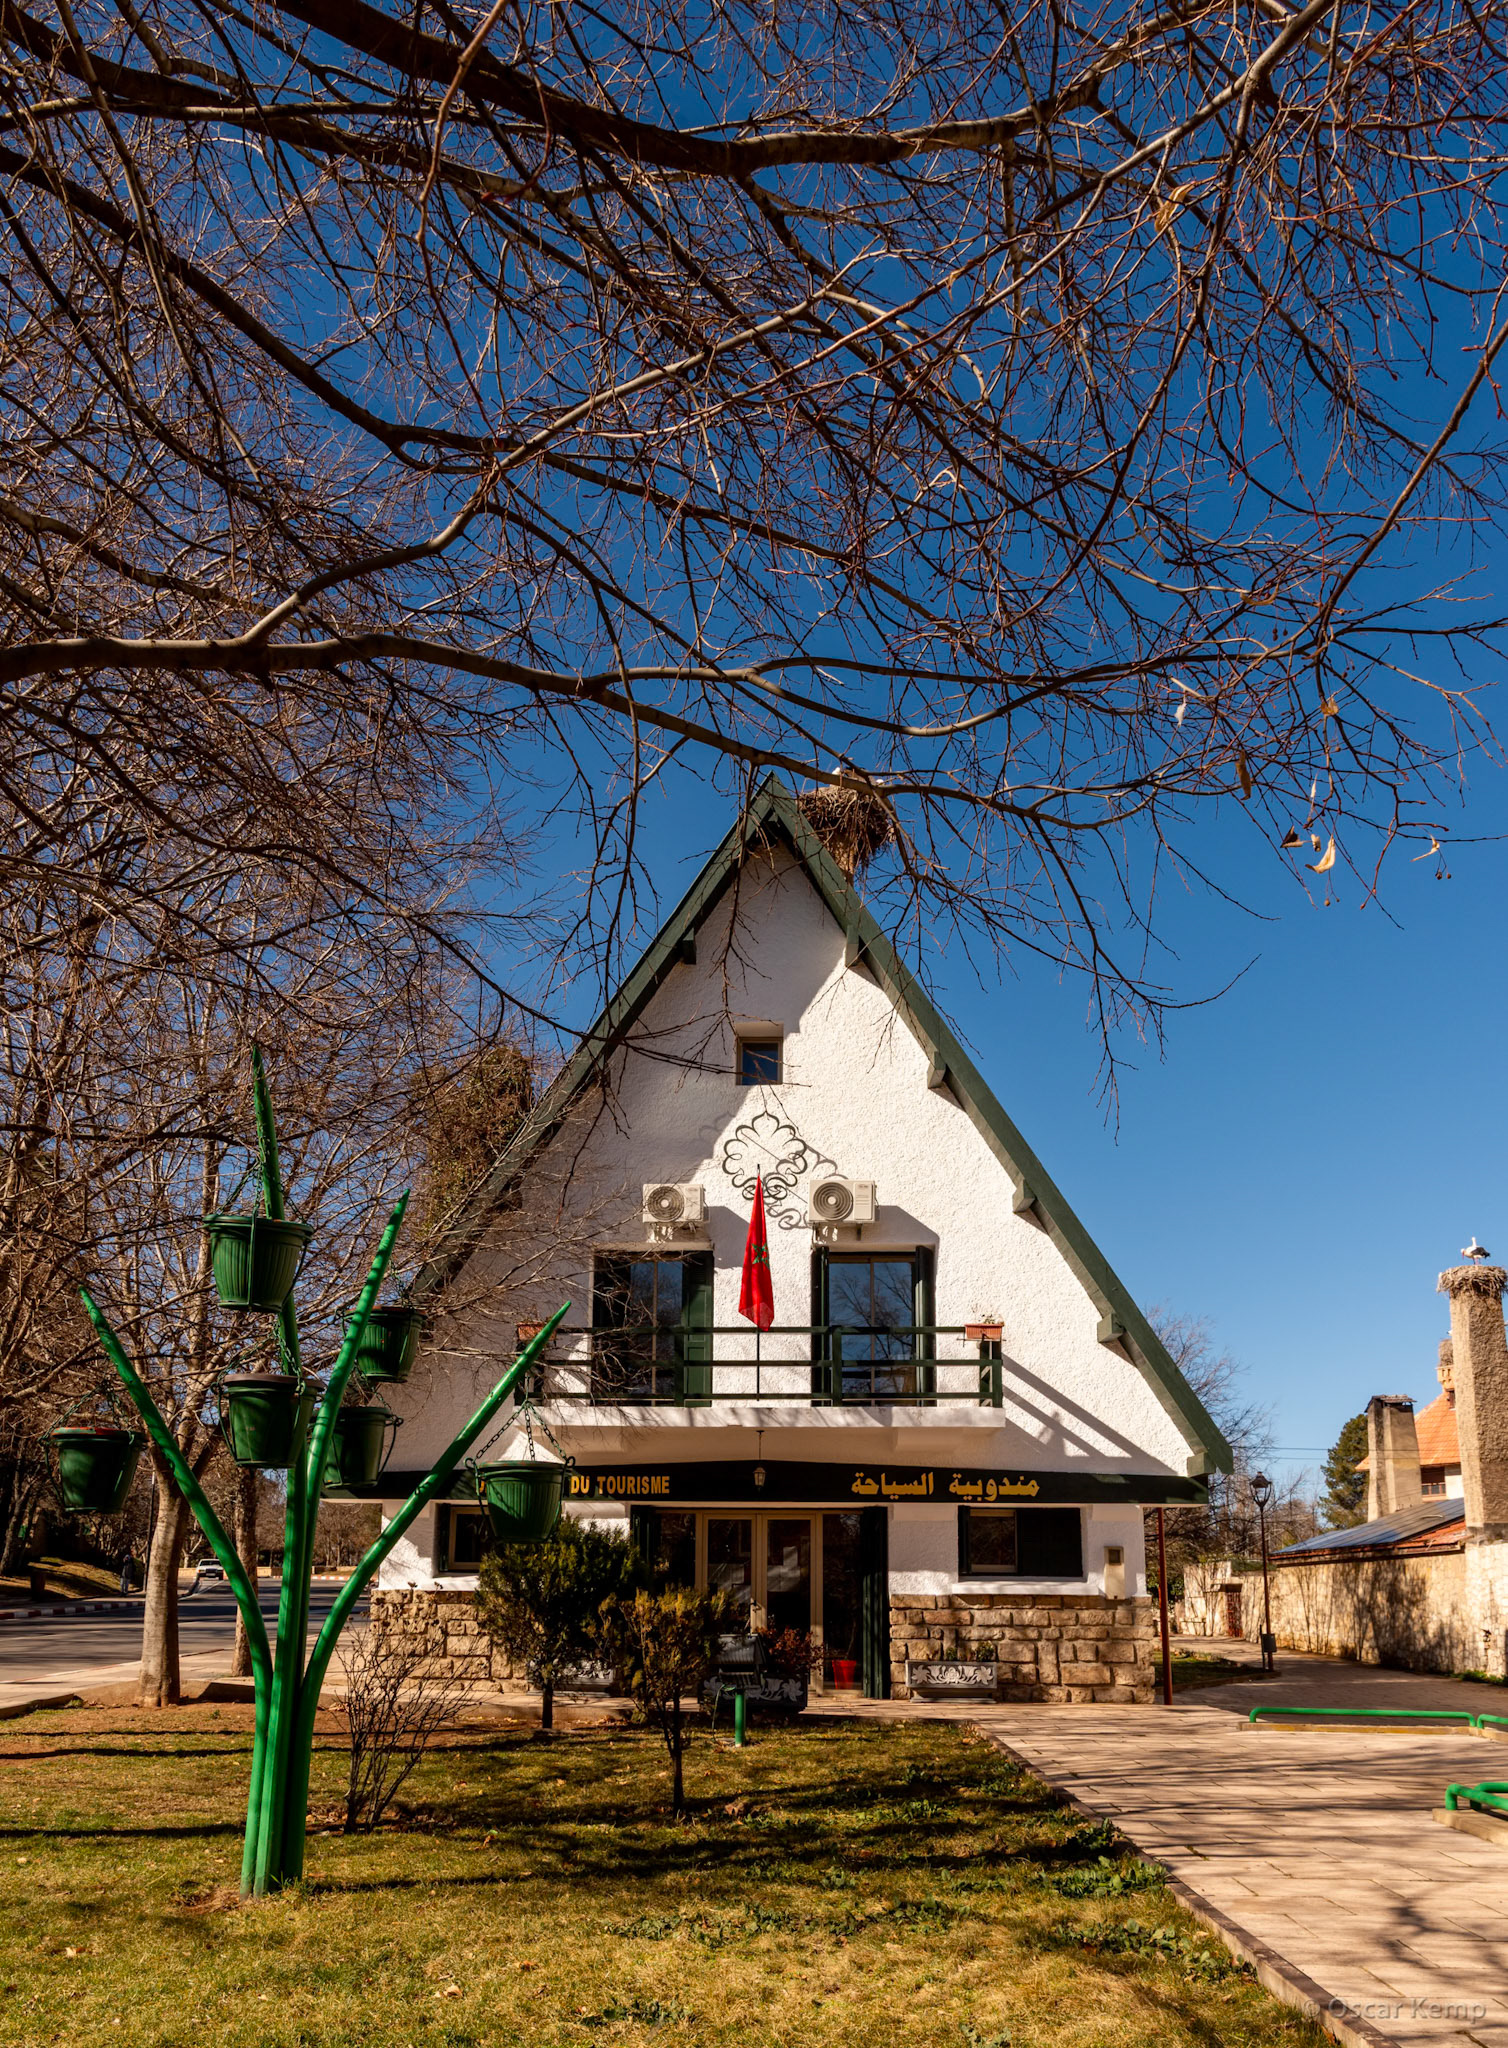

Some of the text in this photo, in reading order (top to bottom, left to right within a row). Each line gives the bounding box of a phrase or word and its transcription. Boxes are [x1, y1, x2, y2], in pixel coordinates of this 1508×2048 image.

[570, 1475, 670, 1494] DU TOURISME
[851, 1471, 1040, 1502] مندوبية السياحة
